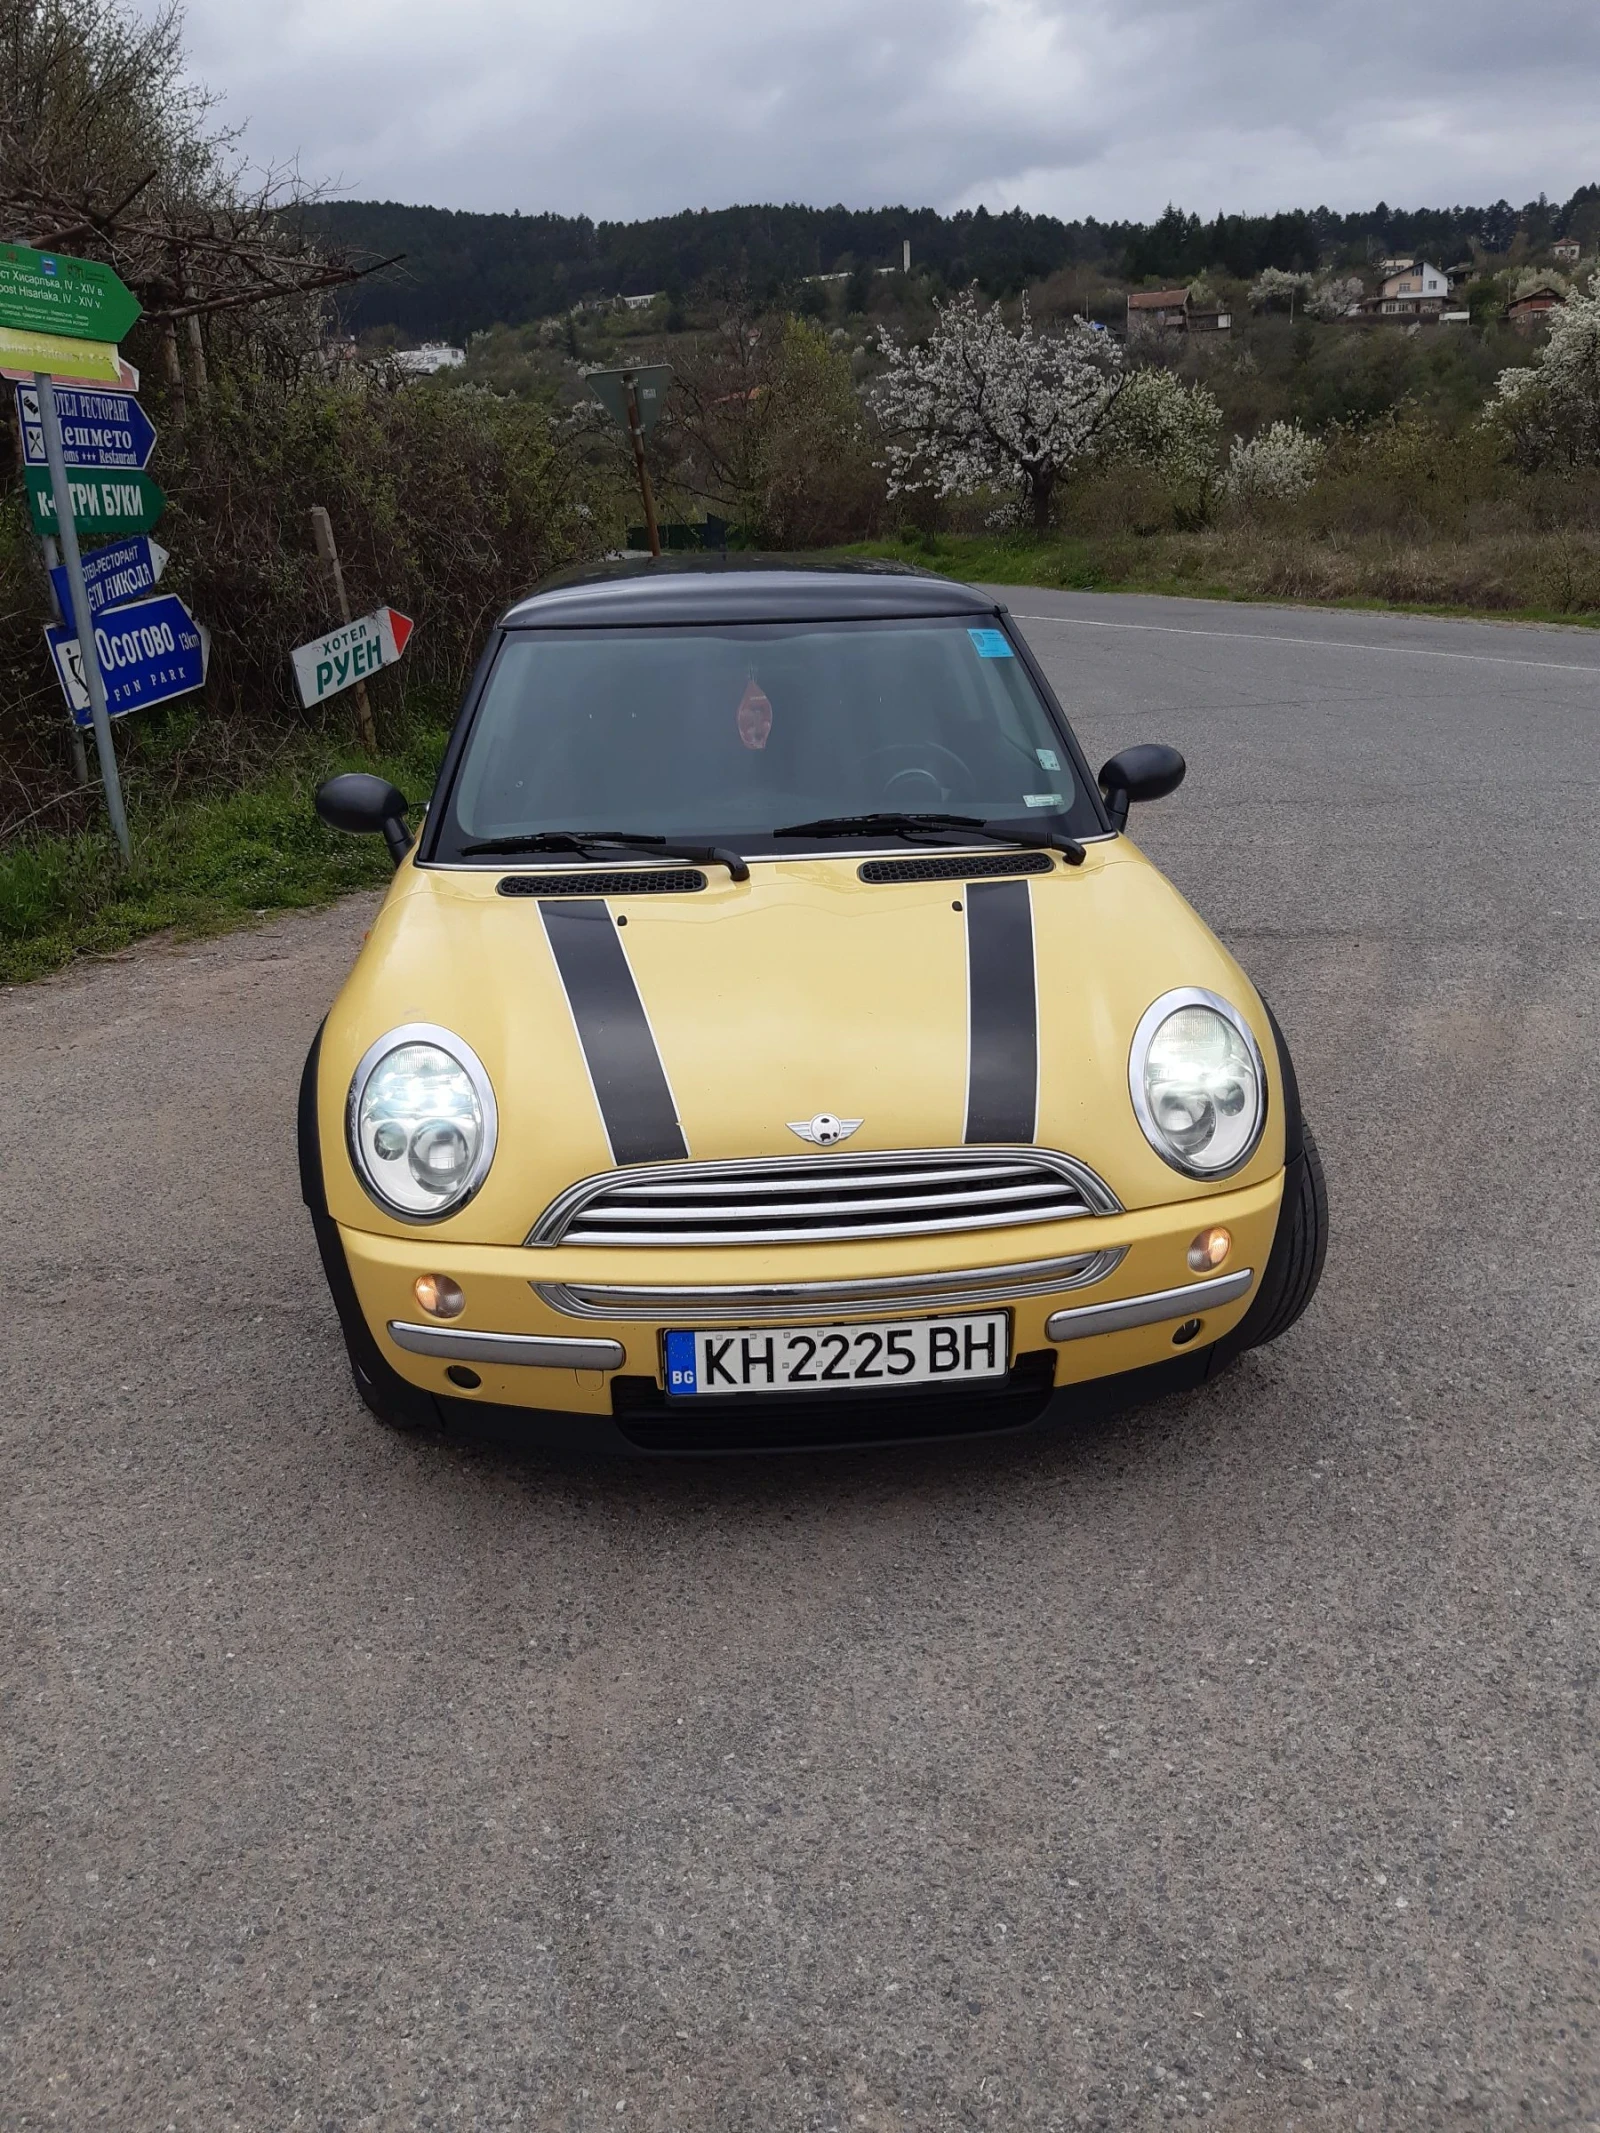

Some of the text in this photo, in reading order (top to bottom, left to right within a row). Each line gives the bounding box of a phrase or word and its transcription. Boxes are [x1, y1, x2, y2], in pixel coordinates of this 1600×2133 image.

[53, 392, 130, 422] ОТЕЛ РЕСТОРАНТ
[99, 449, 138, 465] Restaurant
[67, 483, 101, 517] ТРИ
[101, 483, 144, 517] БУКИ
[81, 545, 138, 583] ОТЕЛ-РЕСТОРАНТ
[104, 562, 153, 601] НИКОЛА
[322, 624, 367, 656] ХОТЕЛ
[316, 635, 383, 696] РУЕН
[113, 667, 187, 702] FUN PARK
[672, 1370, 695, 1385] BG
